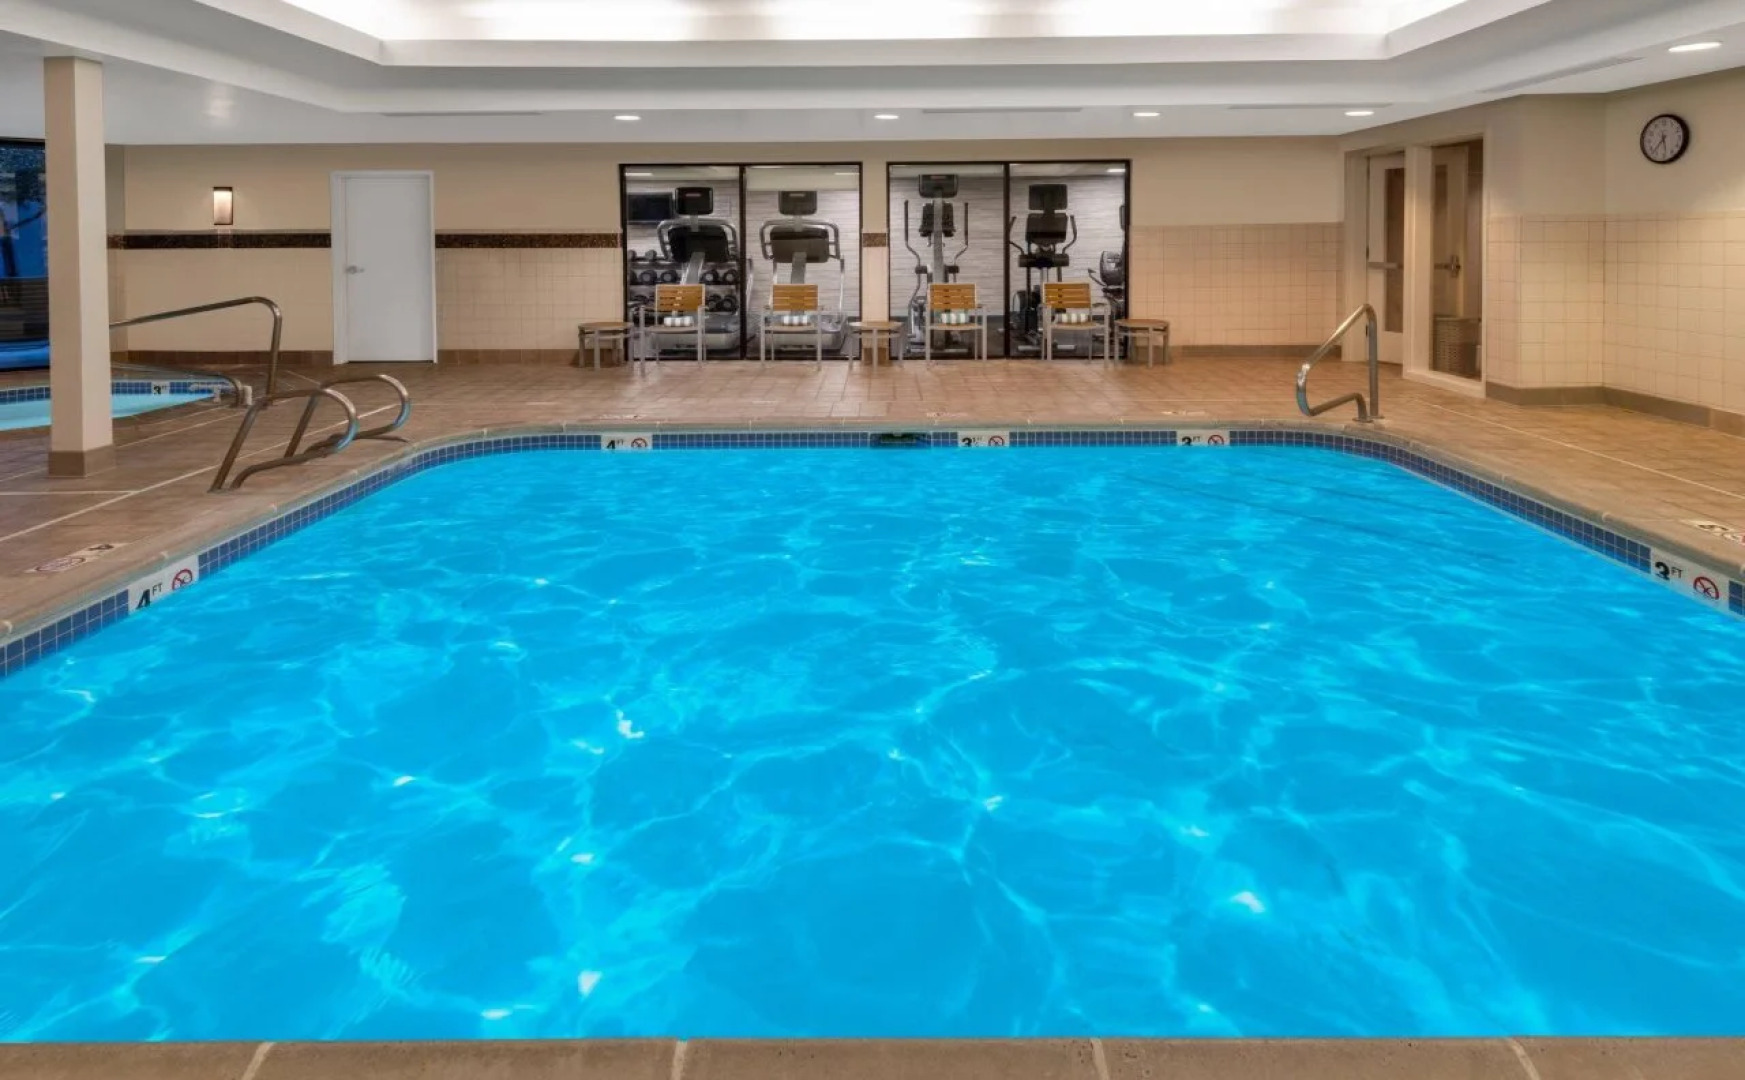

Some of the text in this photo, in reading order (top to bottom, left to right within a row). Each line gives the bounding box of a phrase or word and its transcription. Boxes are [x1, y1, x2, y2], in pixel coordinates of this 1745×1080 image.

[1655, 561, 1684, 581] 3 FT
[152, 582, 163, 597] FT
